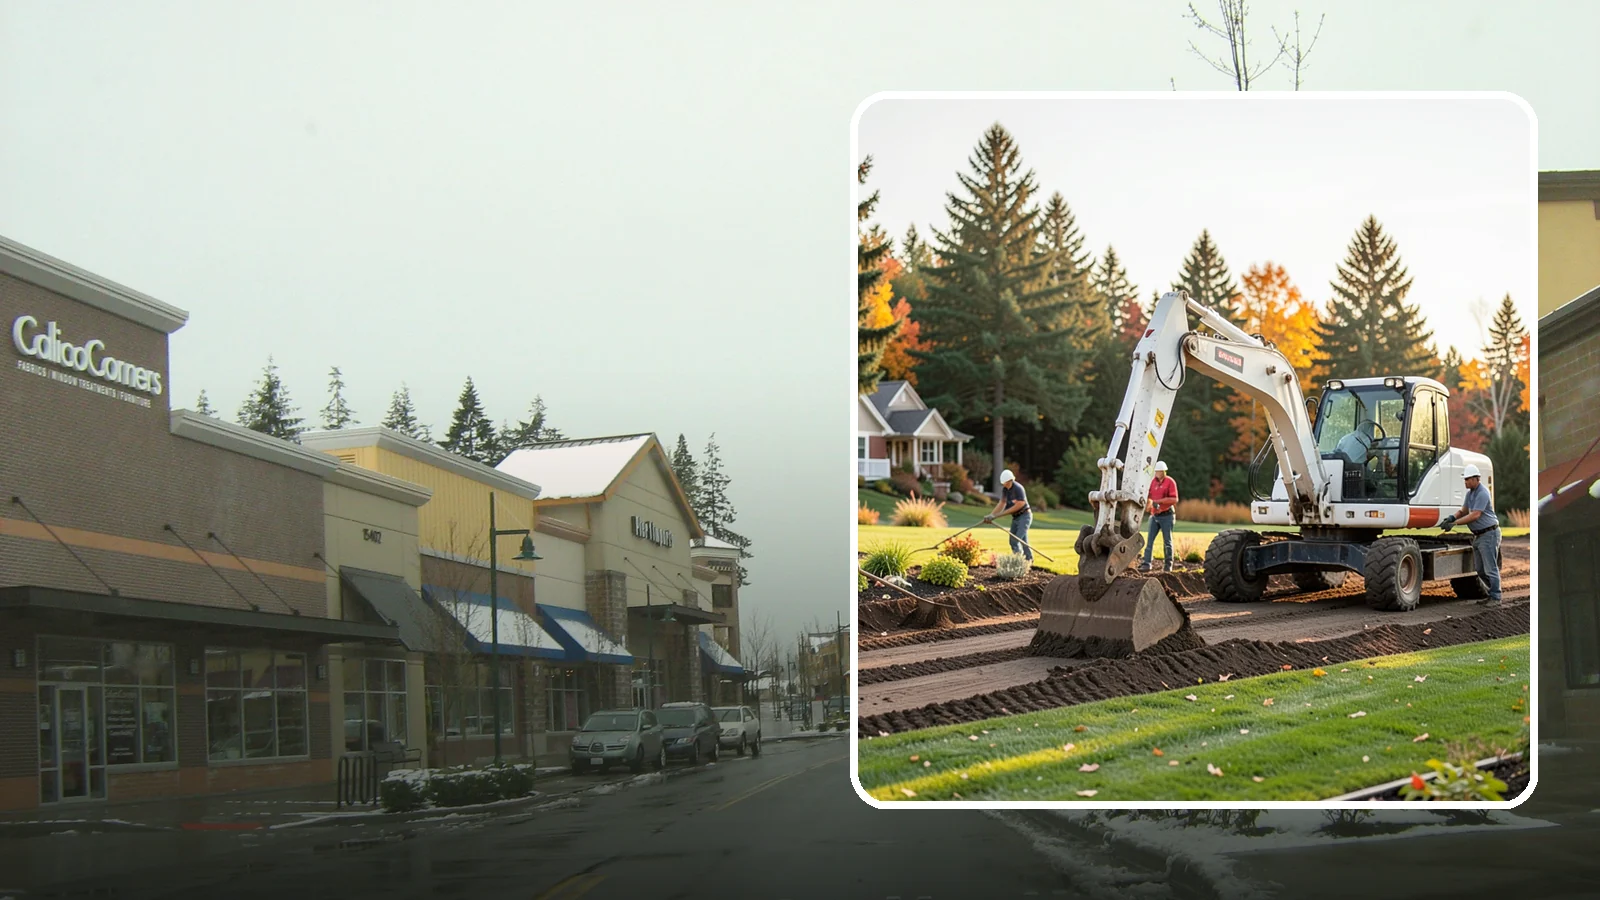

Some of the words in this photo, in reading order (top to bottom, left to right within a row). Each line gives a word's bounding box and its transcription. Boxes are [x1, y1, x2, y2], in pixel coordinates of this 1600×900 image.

[12, 315, 162, 395] CalicoCorners
[17, 359, 47, 378] FABRICS
[51, 370, 78, 387] WINDOW
[78, 378, 117, 398] TREATMENTS
[120, 391, 151, 409] FURNITURE
